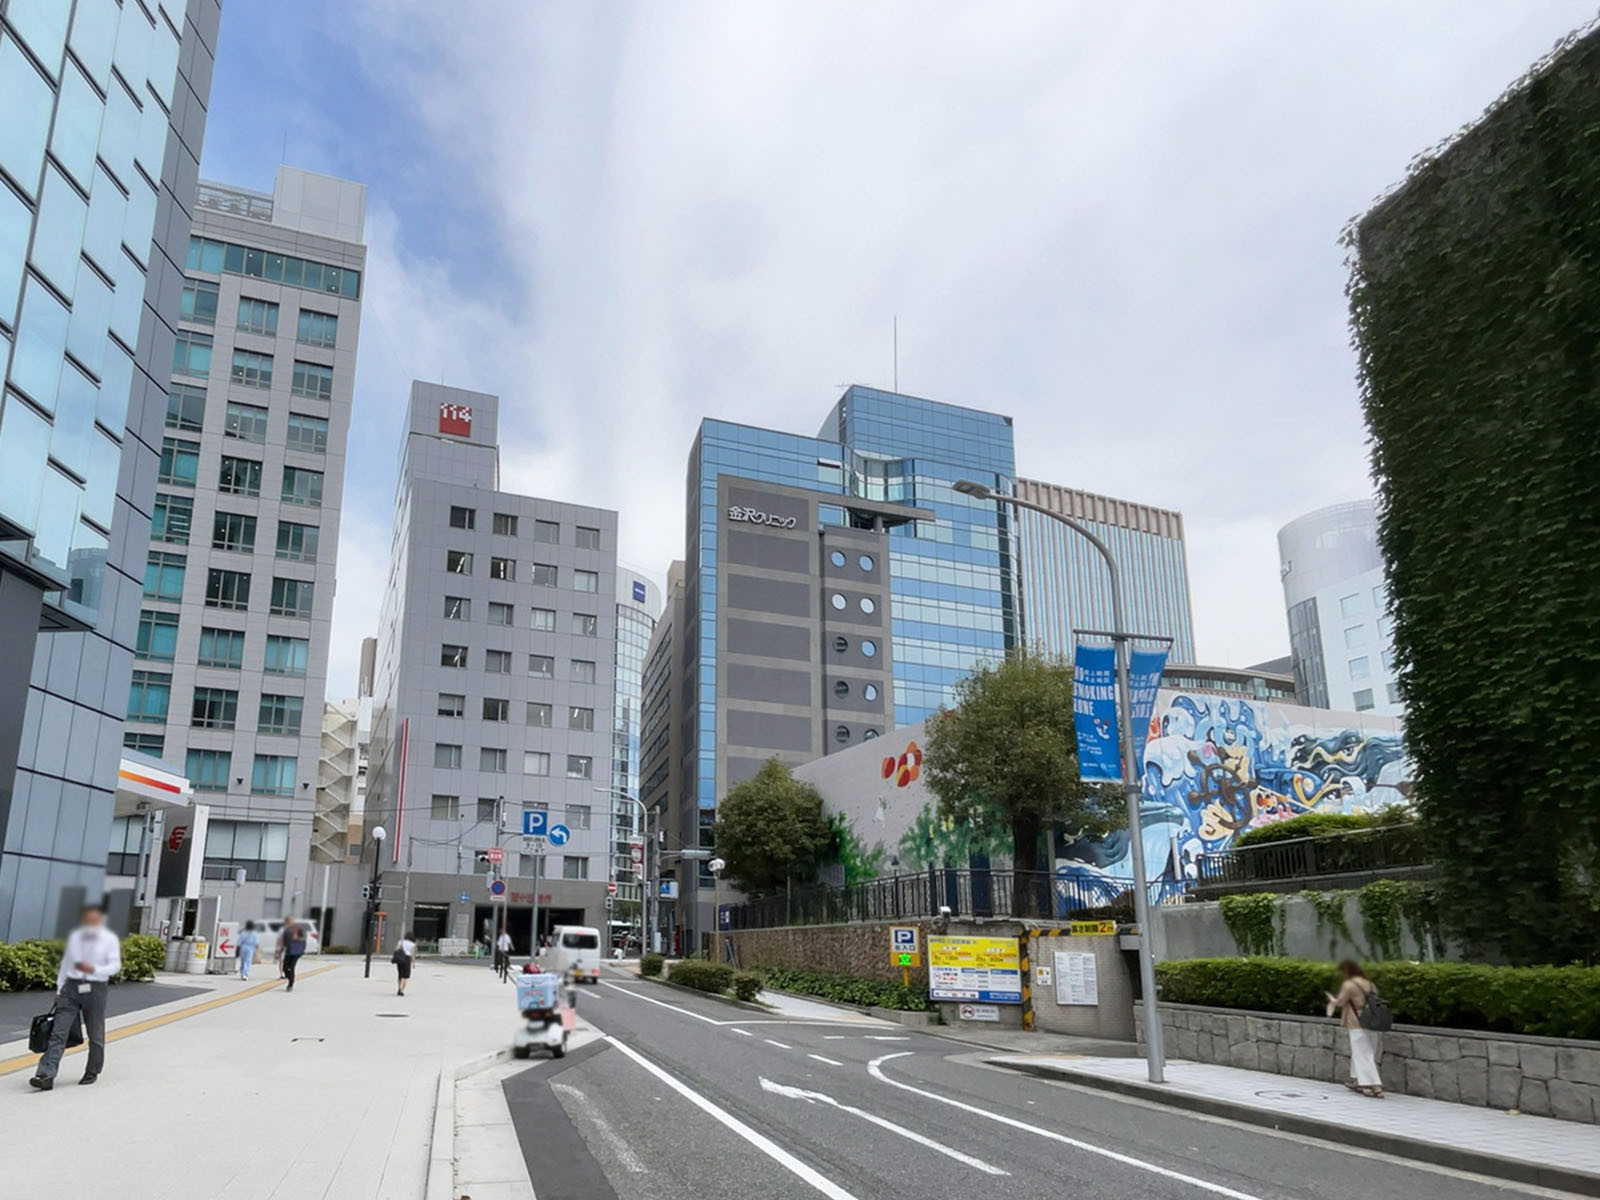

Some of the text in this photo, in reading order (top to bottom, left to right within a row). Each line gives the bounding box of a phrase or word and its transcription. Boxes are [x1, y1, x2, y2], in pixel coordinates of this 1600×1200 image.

[728, 505, 797, 529] 金沢クリニック
[1073, 682, 1114, 701] SMOKING
[1074, 698, 1095, 716] ZONE
[529, 813, 544, 833] P
[897, 931, 912, 942] P
